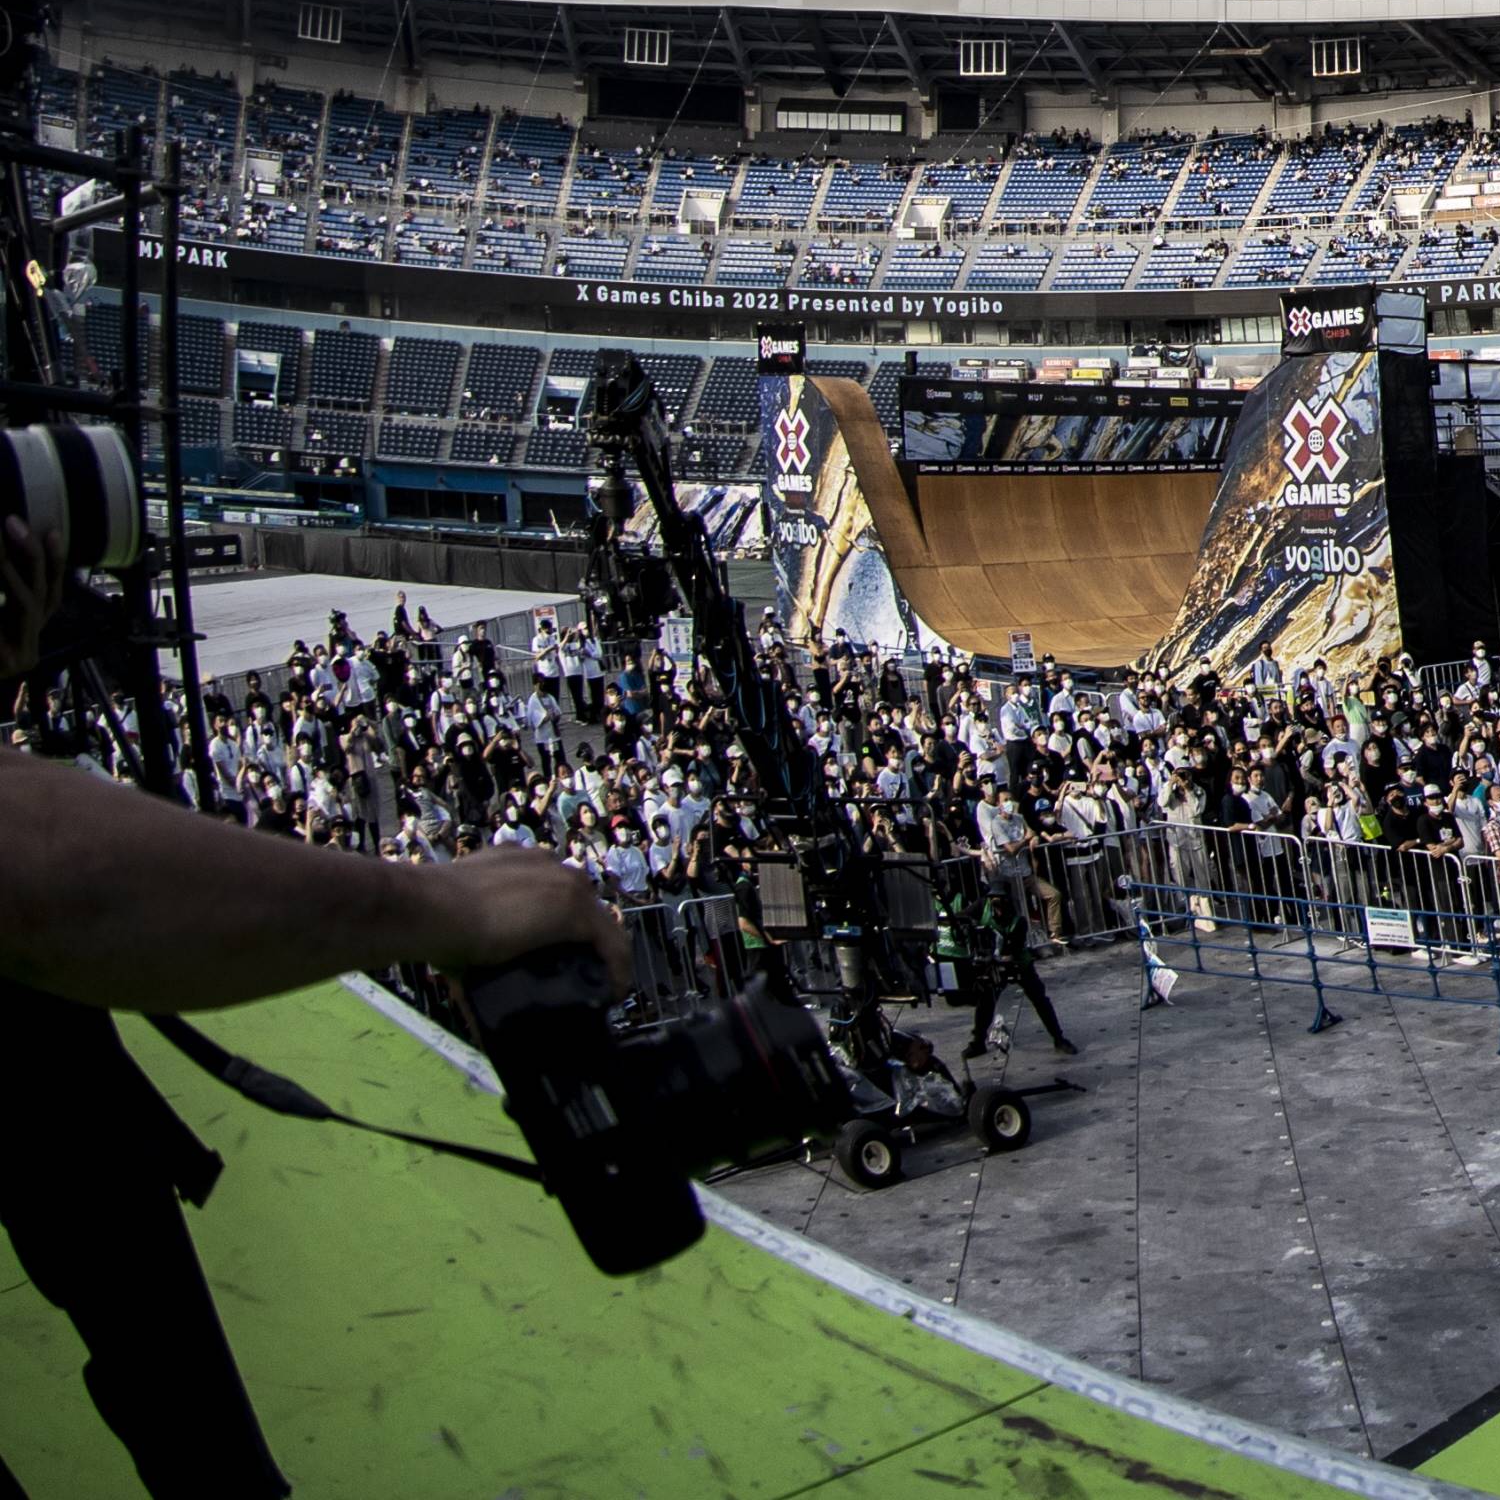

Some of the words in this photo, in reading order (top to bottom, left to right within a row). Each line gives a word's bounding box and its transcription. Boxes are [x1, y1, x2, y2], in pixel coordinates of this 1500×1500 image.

[176, 245, 229, 268] PARK
[577, 284, 589, 301] X
[596, 286, 662, 305] Games
[669, 289, 725, 308] Chiba
[732, 292, 779, 310] 2022
[788, 294, 894, 313] Presented
[902, 297, 925, 317] by
[932, 297, 1003, 317] Yogibo
[1311, 306, 1365, 329] GAMES
[1326, 328, 1351, 339] CHIBA
[772, 340, 799, 355] GAMES
[777, 474, 813, 493] GAMES
[1284, 483, 1352, 506] GAMES
[1301, 526, 1328, 535] Presented
[1329, 526, 1337, 536] by
[1285, 539, 1361, 580] yogibo
